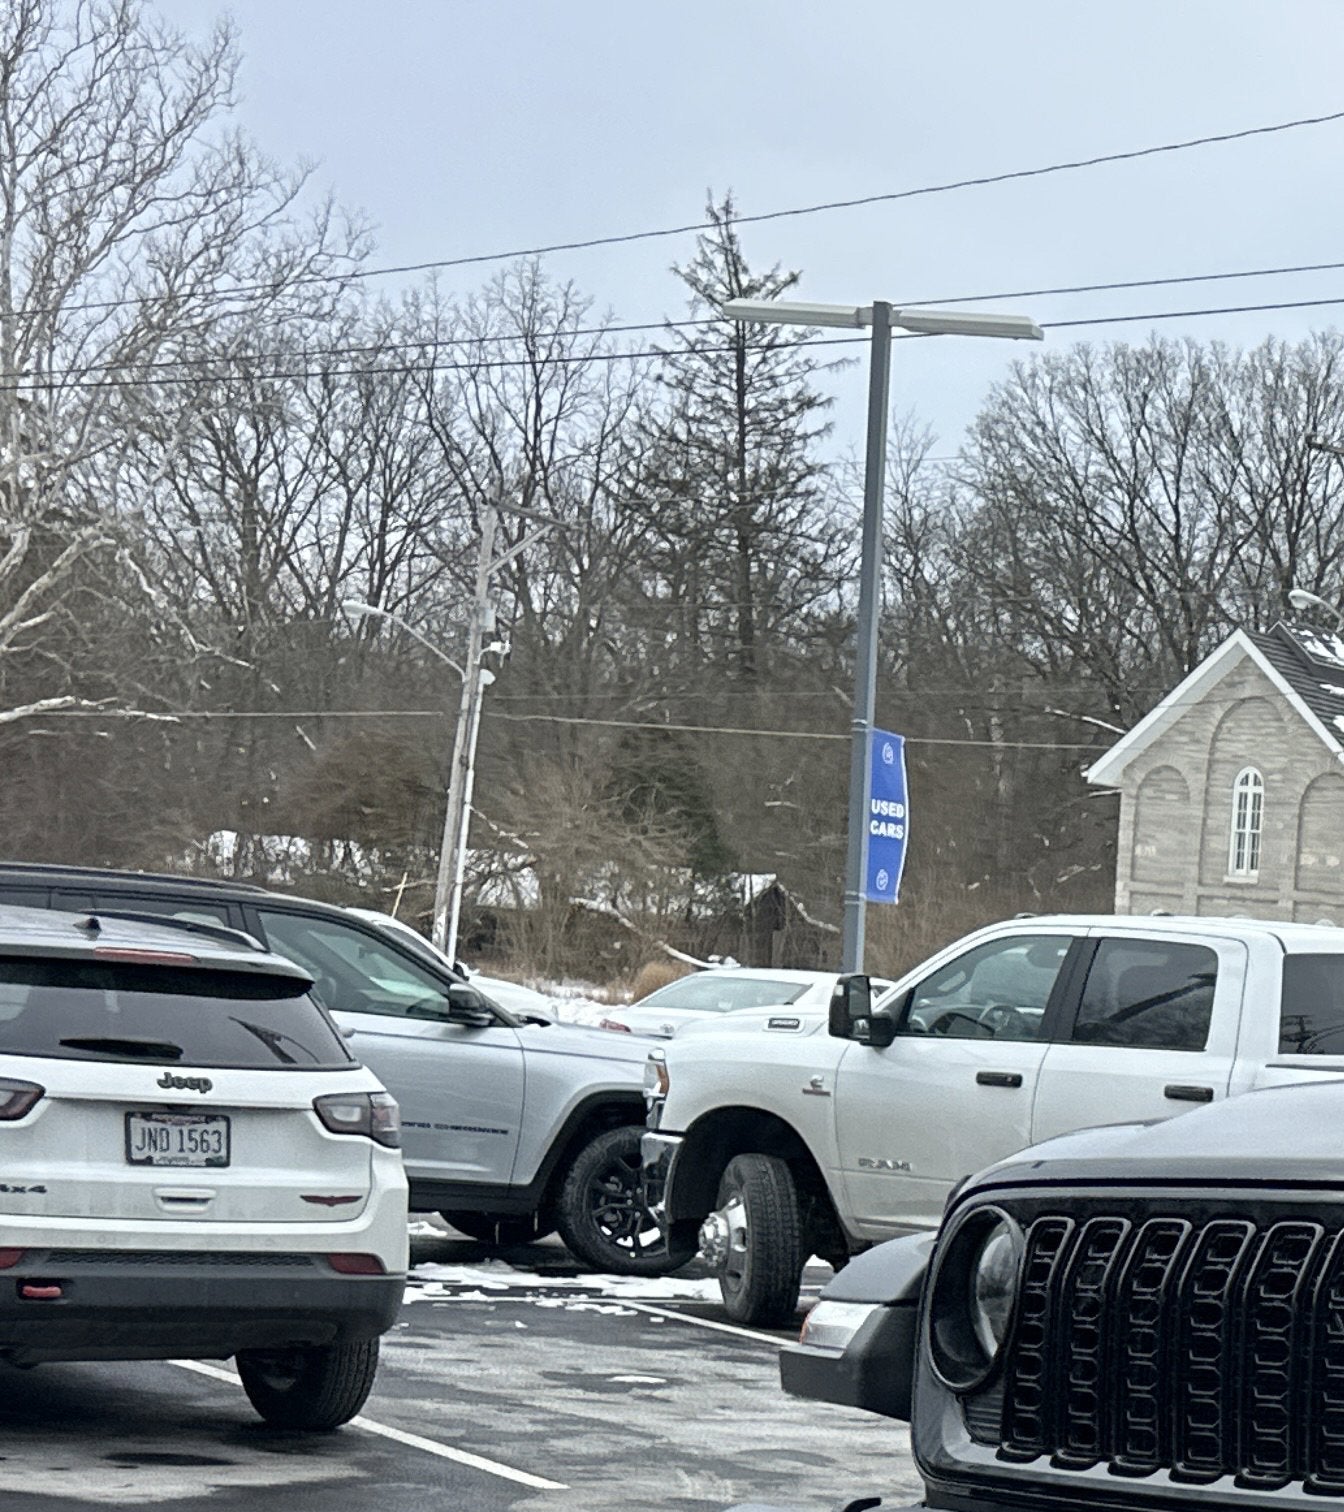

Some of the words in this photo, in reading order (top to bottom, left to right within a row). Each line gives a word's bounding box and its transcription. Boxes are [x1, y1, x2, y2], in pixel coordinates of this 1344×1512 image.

[871, 799, 904, 818] USED
[870, 820, 904, 839] CARS
[157, 1071, 213, 1094] Jeep
[177, 1128, 222, 1154] 1563
